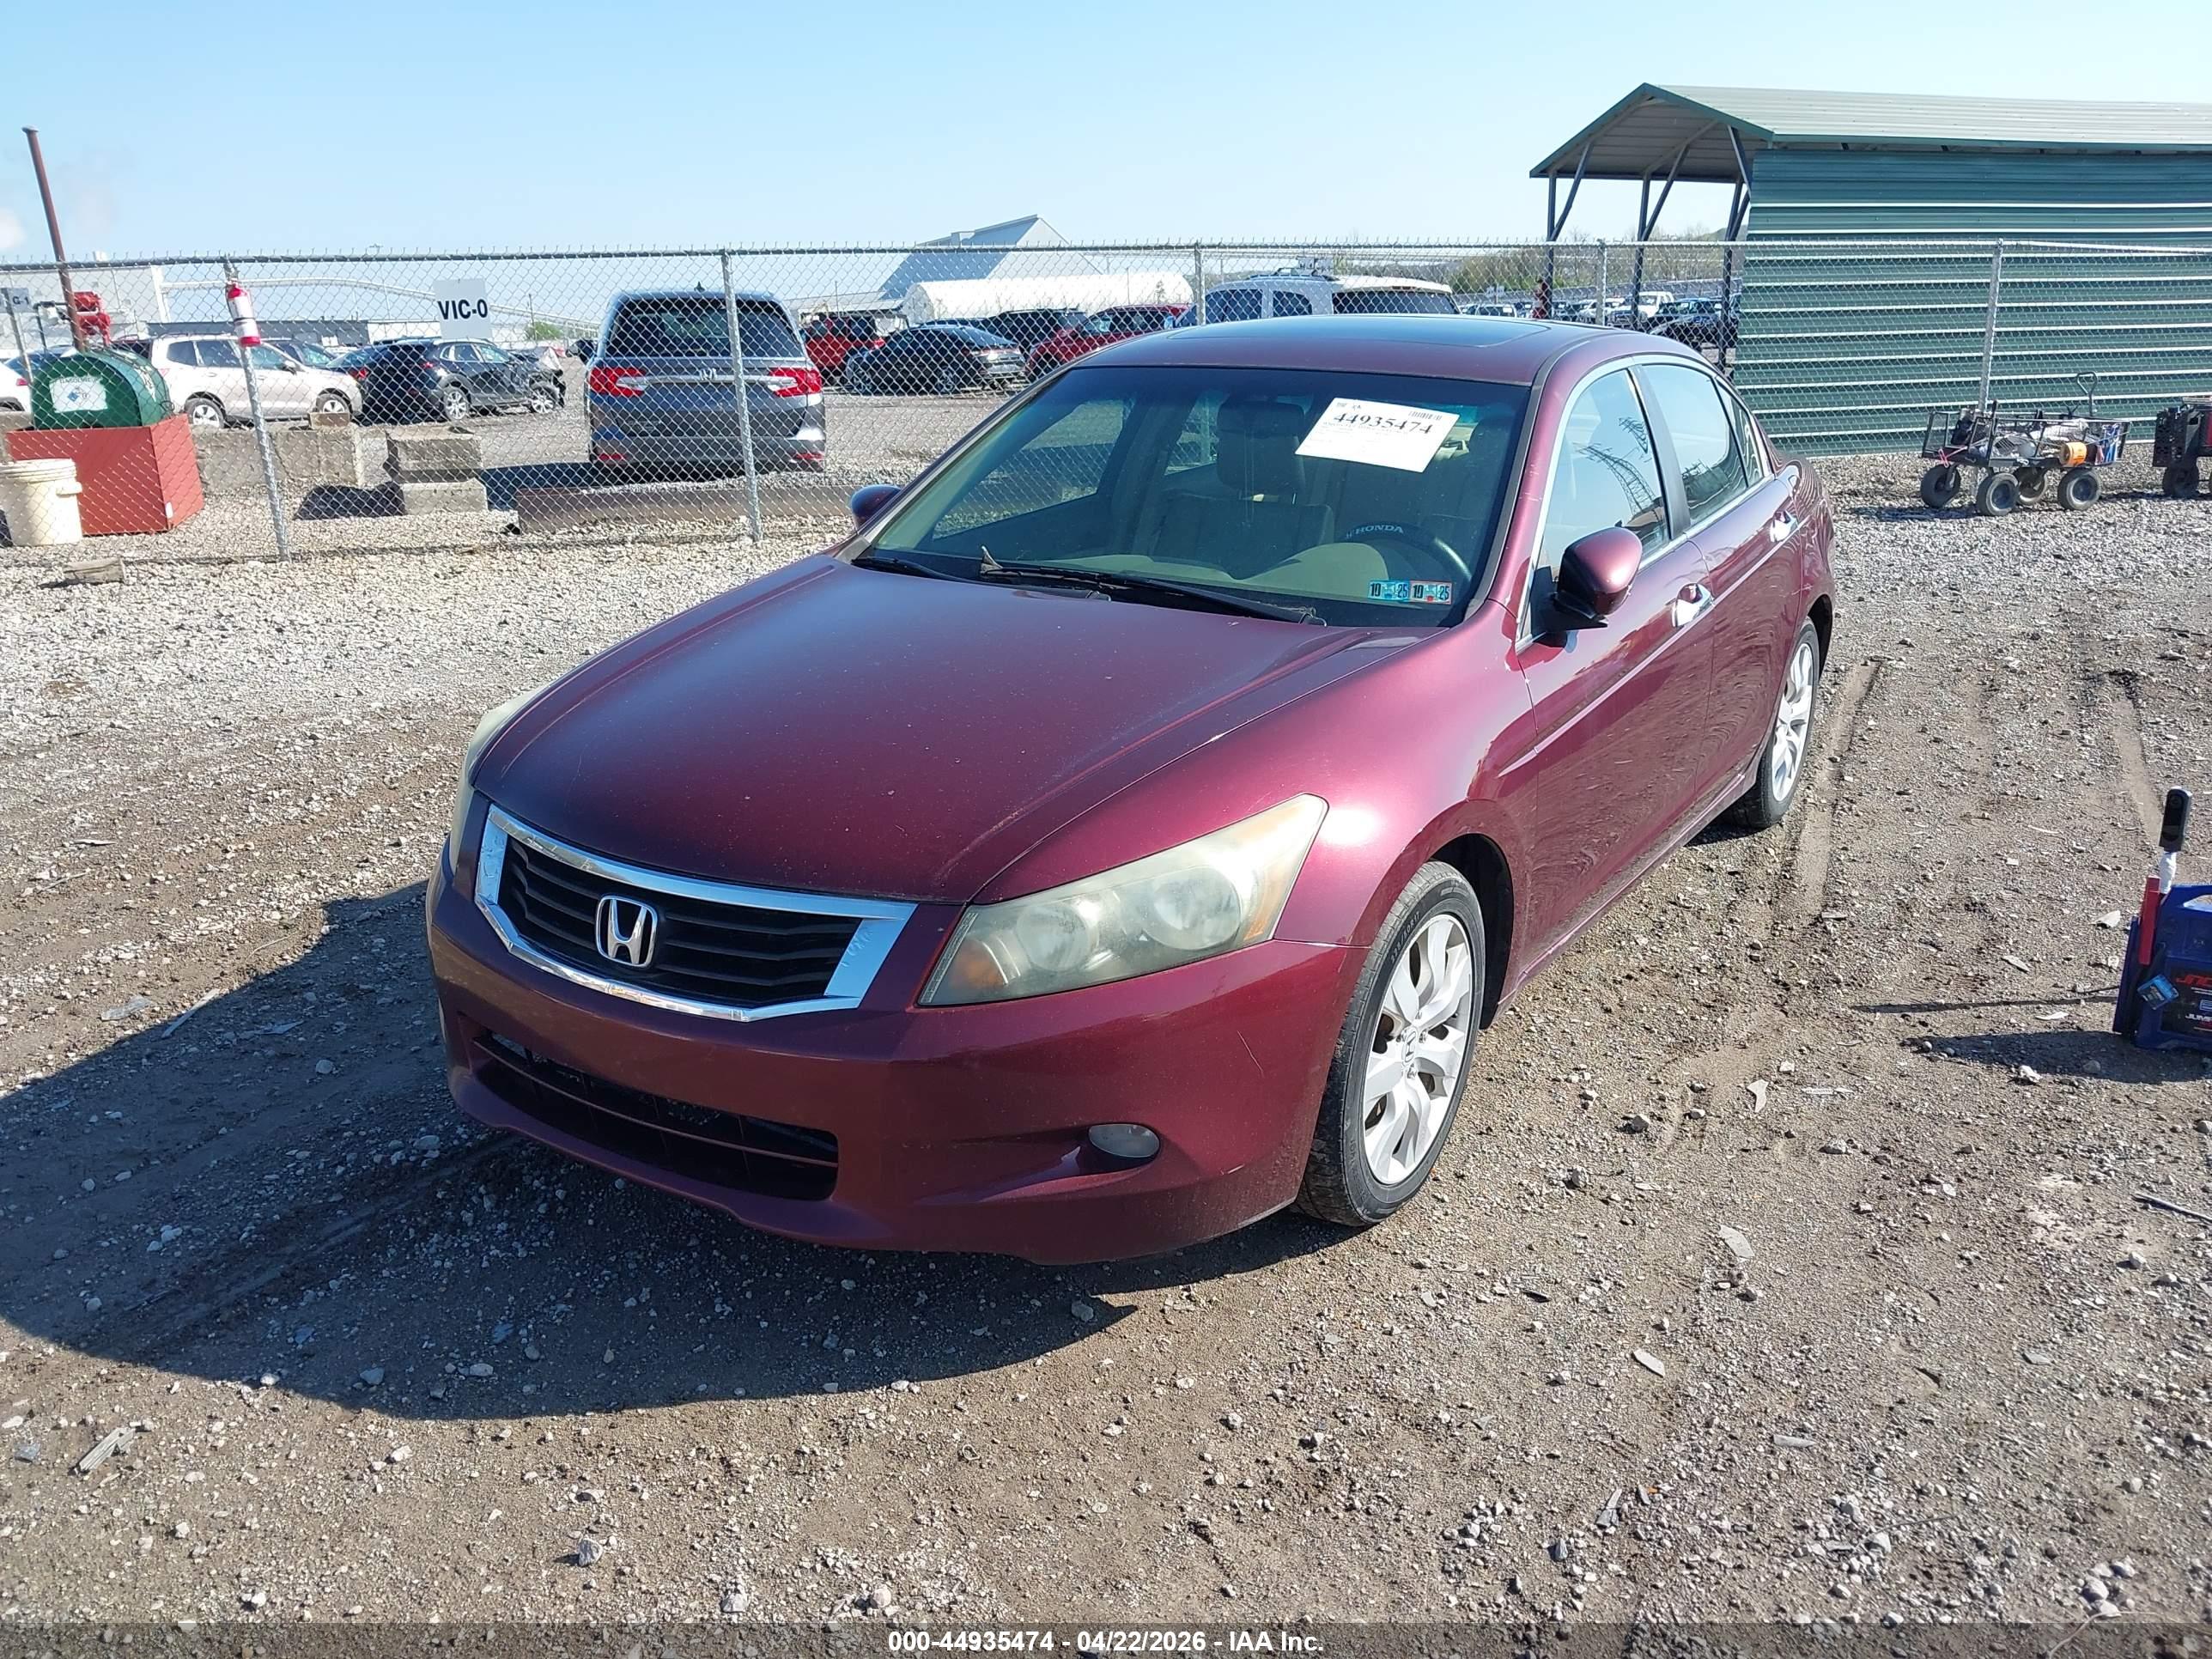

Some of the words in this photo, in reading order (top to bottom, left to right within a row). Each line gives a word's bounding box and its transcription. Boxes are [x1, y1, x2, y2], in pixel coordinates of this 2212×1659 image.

[1334, 413, 1434, 434] 44935474
[1355, 525, 1404, 534] HONDA
[1370, 582, 1382, 597] 10
[1397, 583, 1408, 599] 25
[1413, 584, 1425, 599] 10
[1438, 585, 1450, 601] 25
